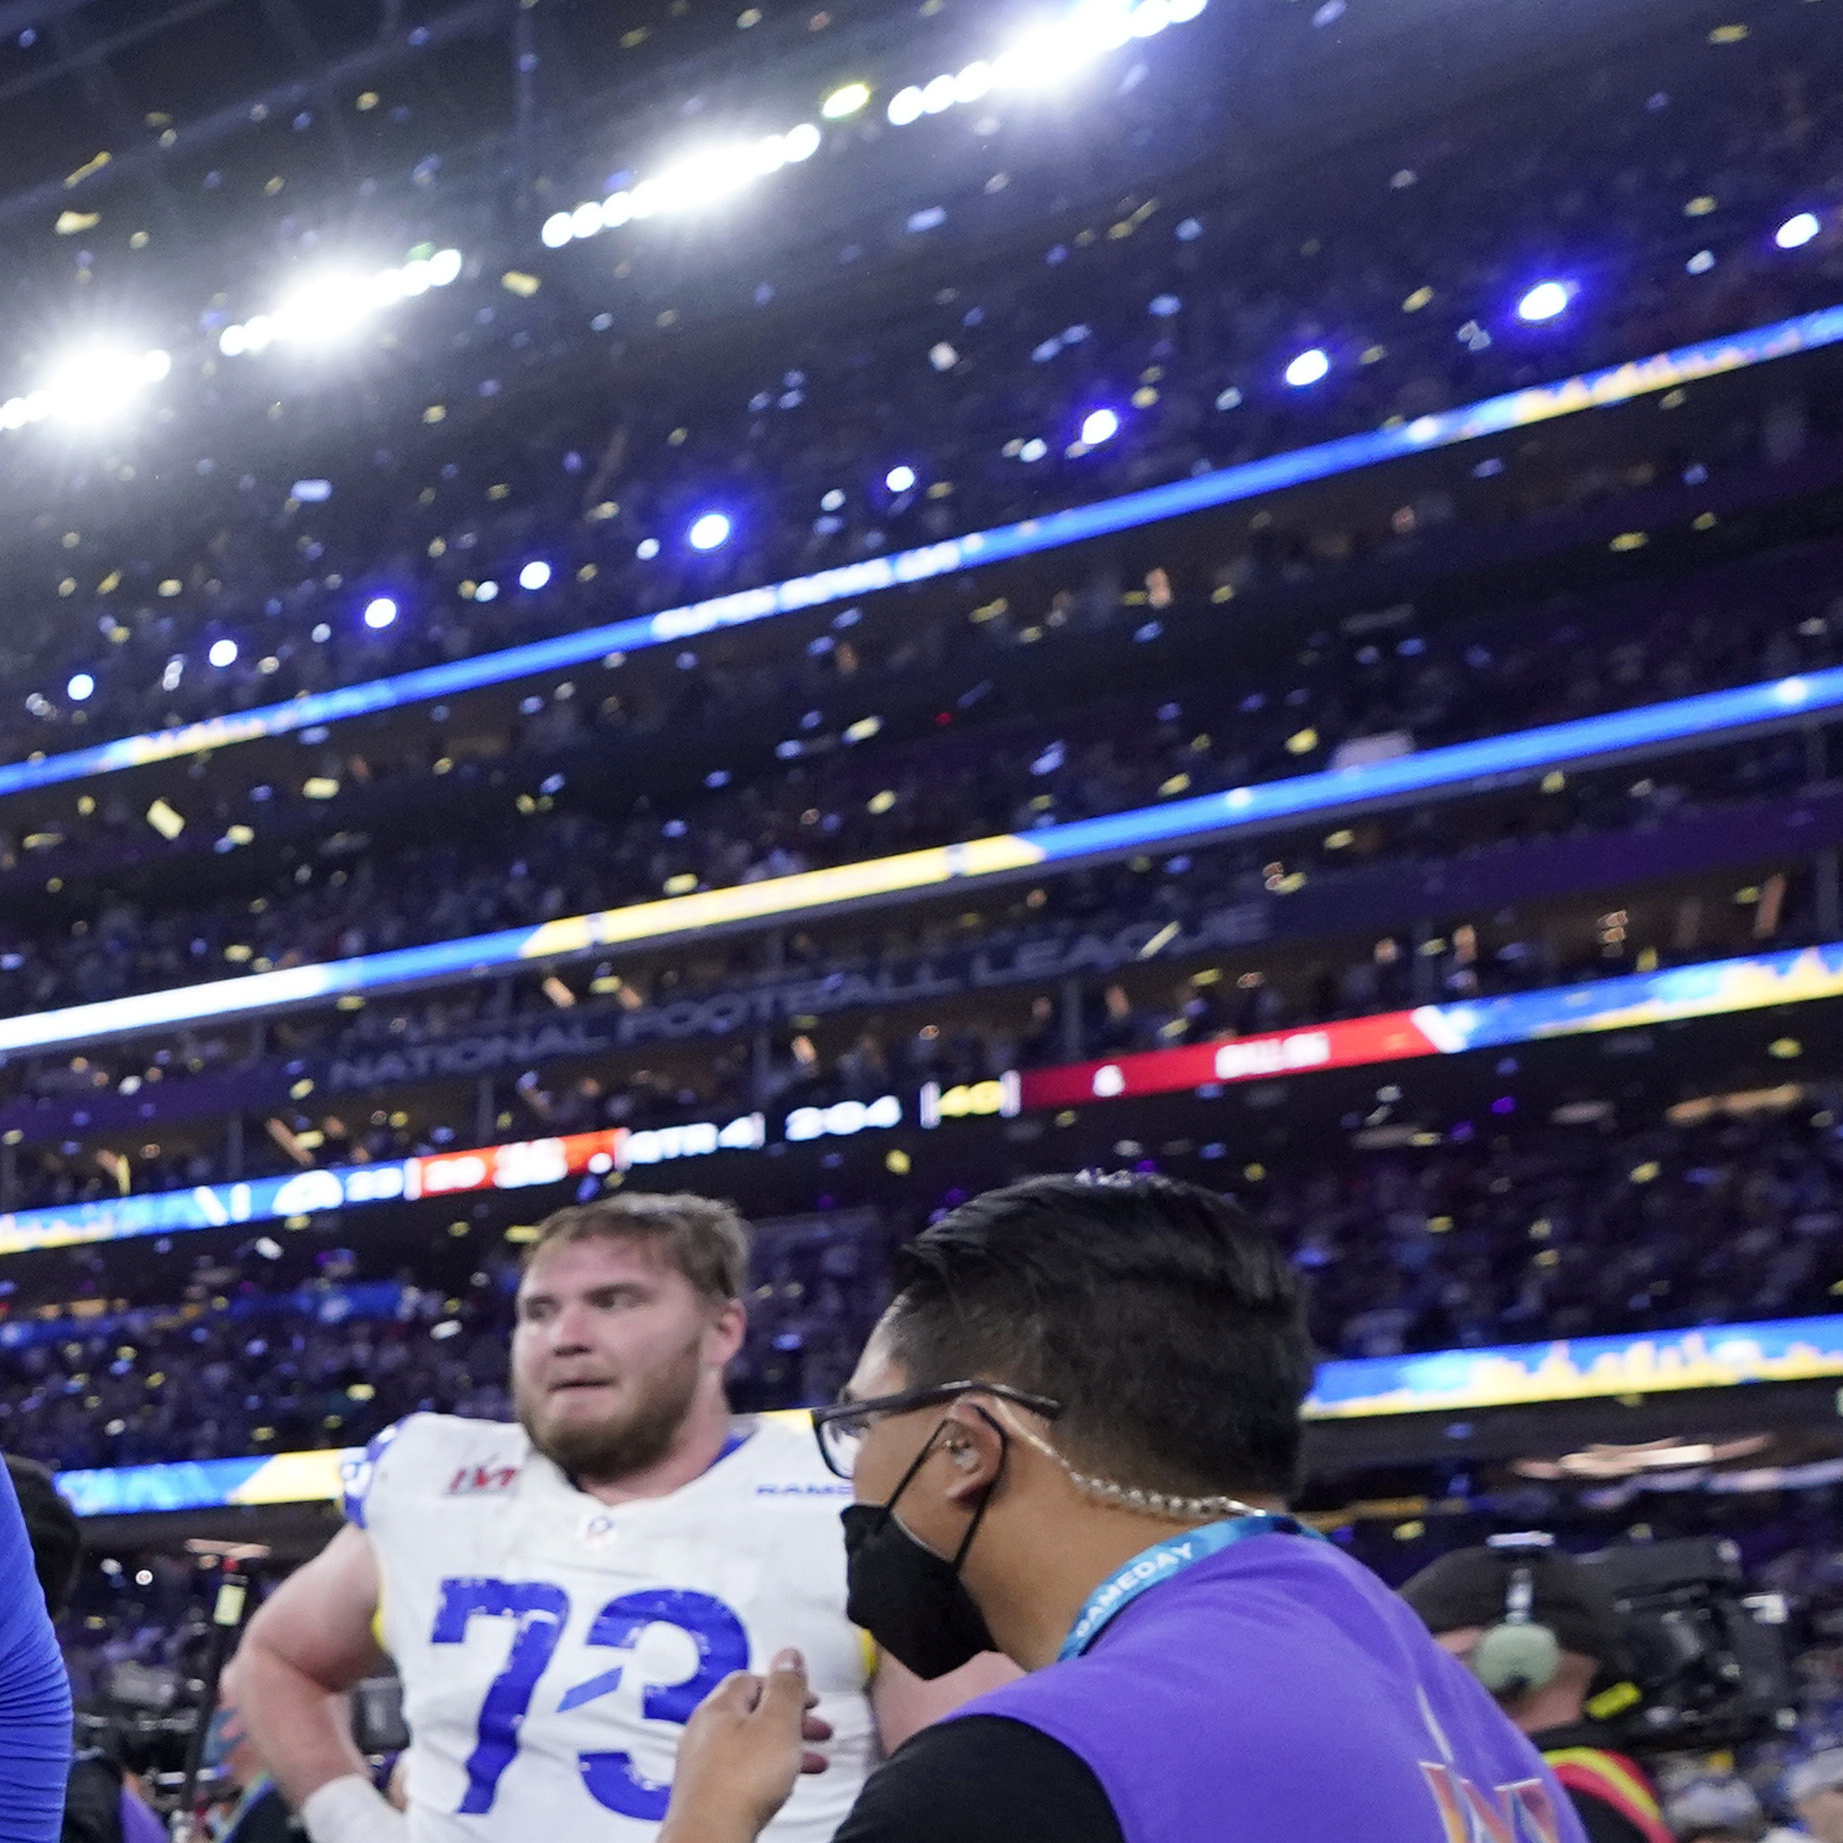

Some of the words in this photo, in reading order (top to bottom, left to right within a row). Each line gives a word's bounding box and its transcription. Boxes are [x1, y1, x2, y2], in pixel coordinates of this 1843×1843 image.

[329, 1026, 608, 1087] NATIONAL
[617, 963, 964, 1038] FOOTBALL
[971, 905, 1270, 983] LEAGUE
[1075, 1541, 1193, 1639] GAMEDAY
[431, 1576, 754, 1823] 73
